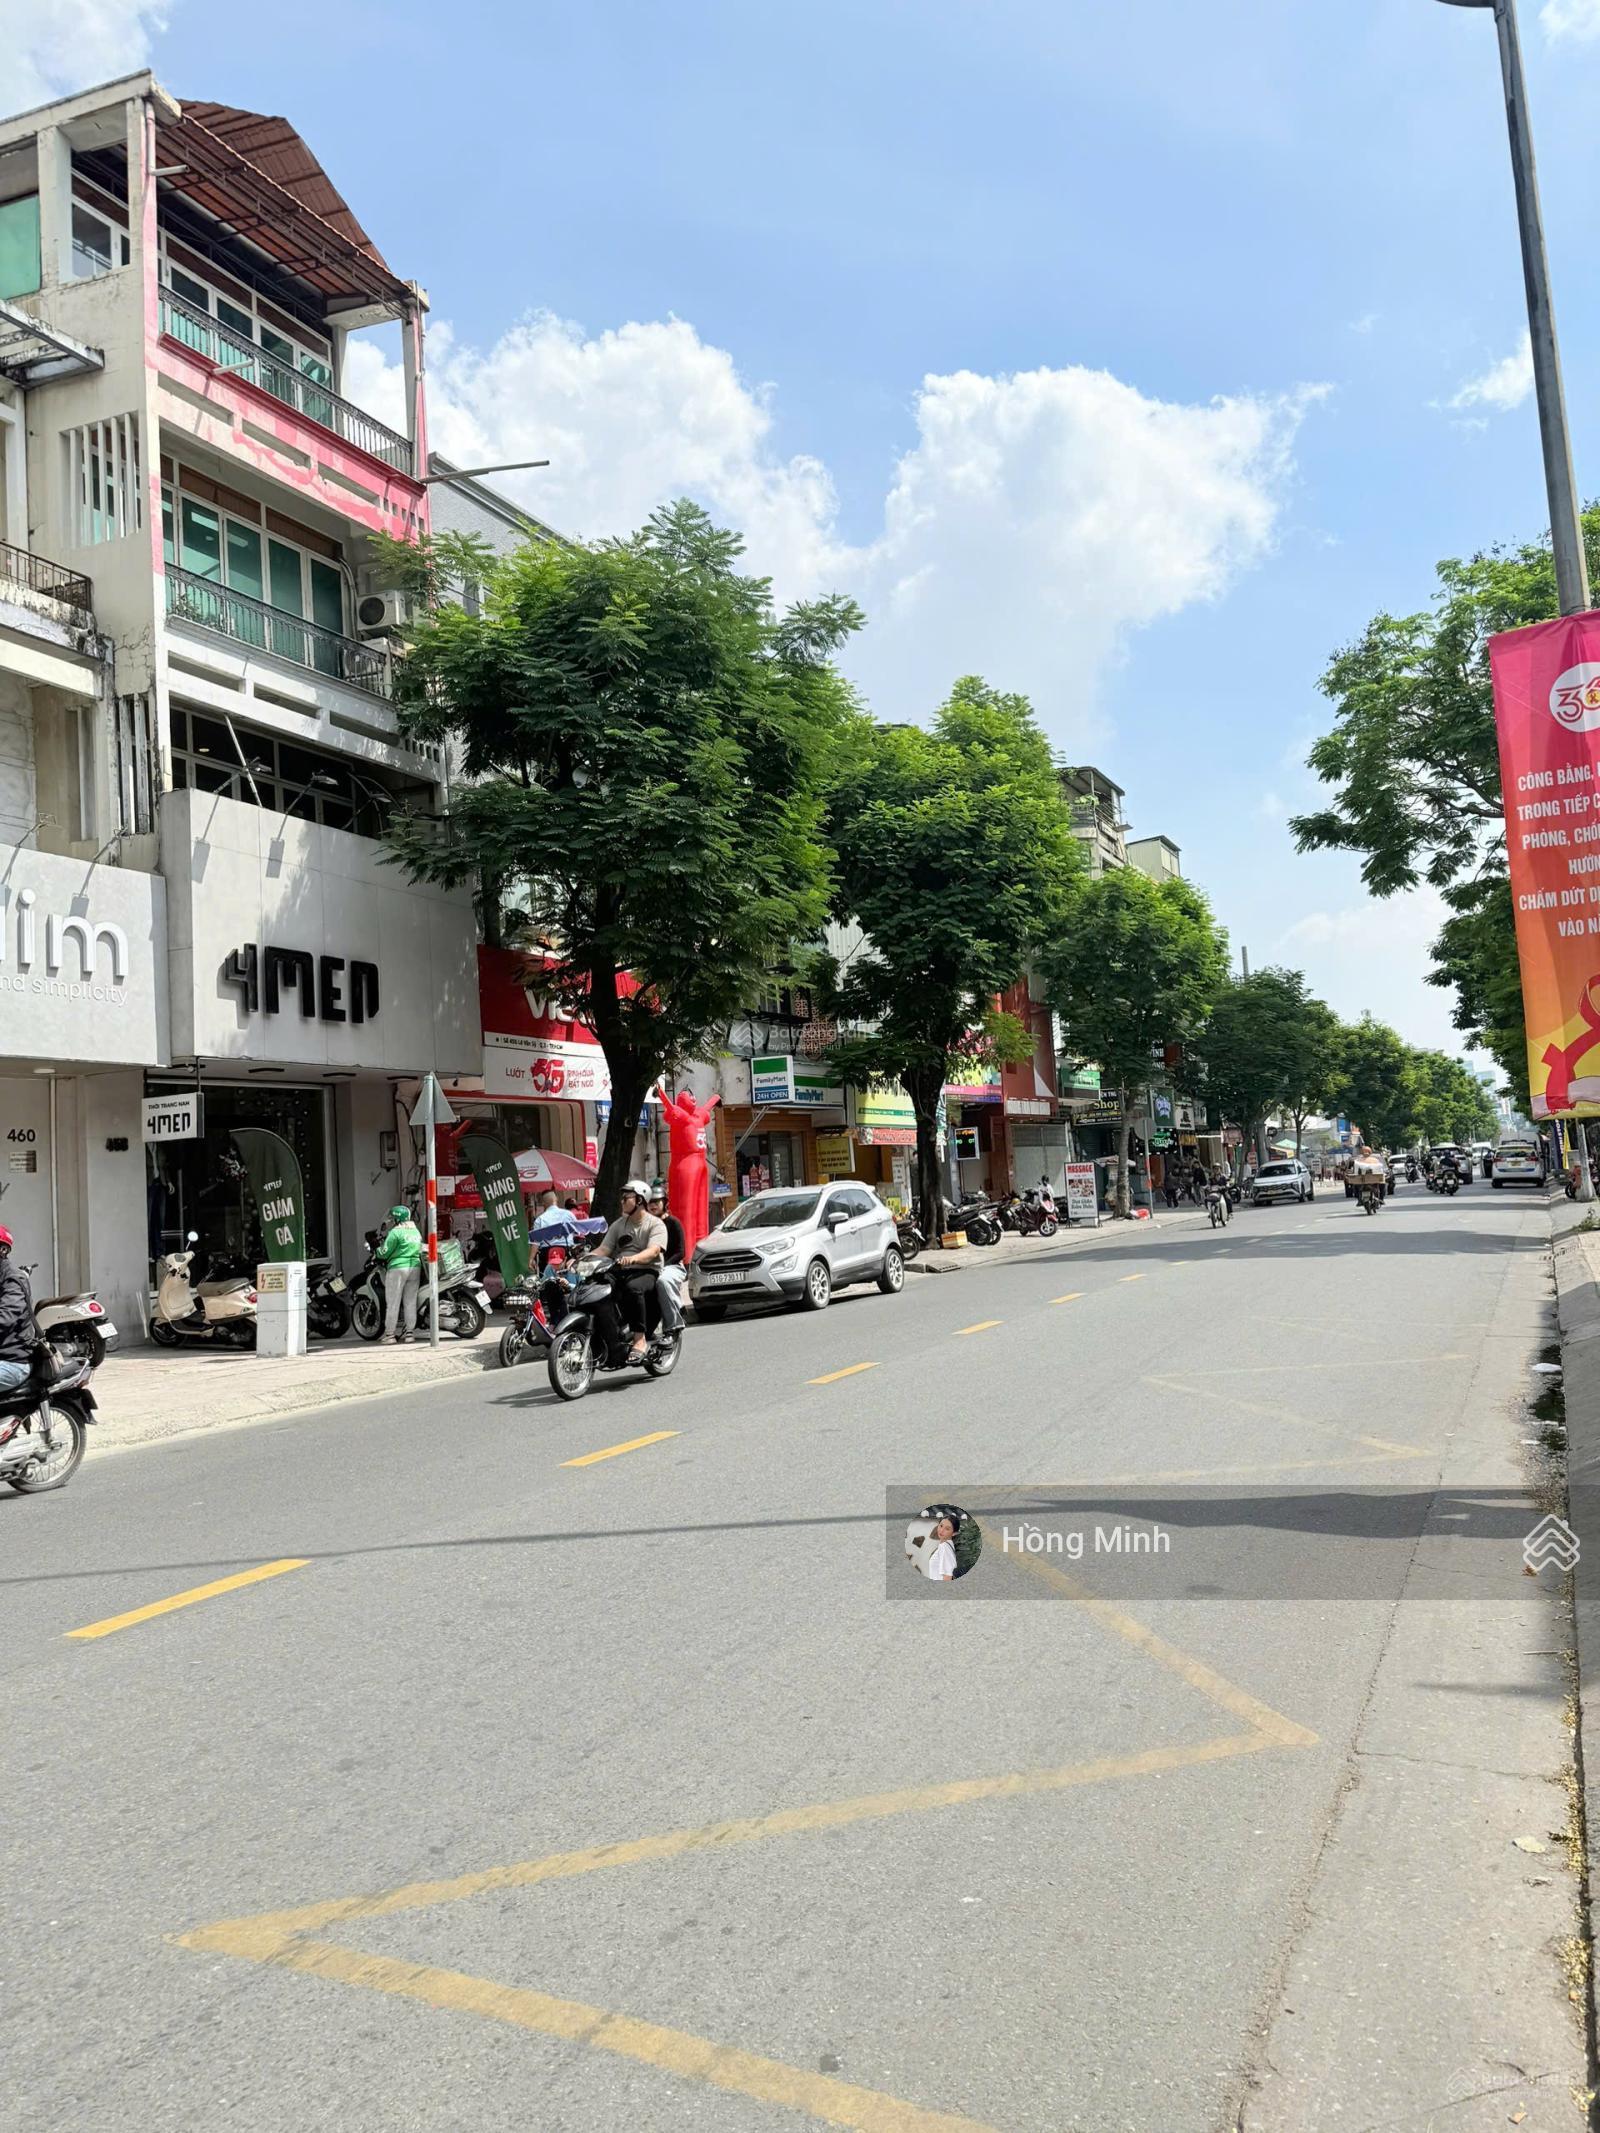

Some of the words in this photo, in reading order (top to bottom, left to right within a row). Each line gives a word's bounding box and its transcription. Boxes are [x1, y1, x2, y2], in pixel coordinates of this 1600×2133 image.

[1518, 770, 1554, 791] CÔNG
[1557, 762, 1594, 785] BẰNG,
[1517, 800, 1560, 821] TRONG
[1563, 791, 1590, 814] TIẾP
[1522, 828, 1571, 850] PHÒNG,
[1519, 887, 1557, 910] CHẤM
[1558, 918, 1584, 936] VÀO
[1588, 914, 1600, 934] N
[31, 976, 128, 1007] simplicity
[225, 943, 380, 1023] 4MEN
[757, 1076, 786, 1085] FamilyMart
[770, 1091, 788, 1099] OPEN
[1094, 1100, 1120, 1110] Shop
[147, 1112, 191, 1134] 4MEN
[7, 1129, 36, 1143] 460
